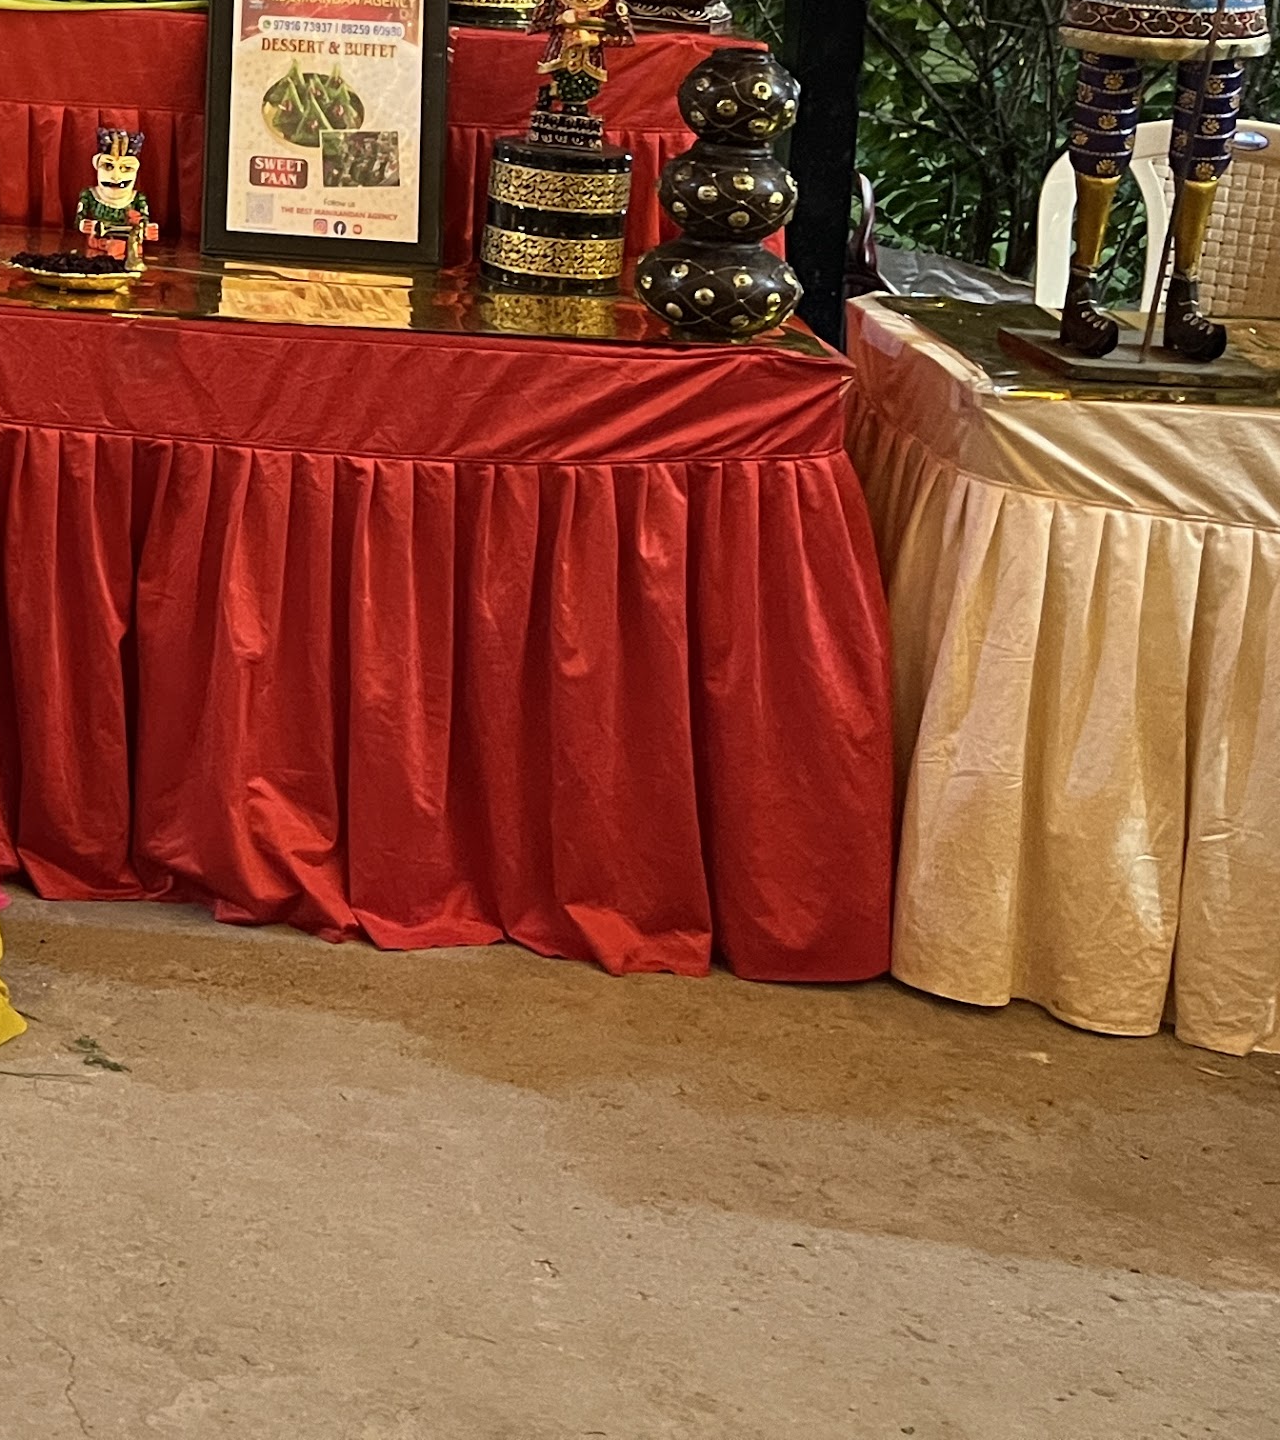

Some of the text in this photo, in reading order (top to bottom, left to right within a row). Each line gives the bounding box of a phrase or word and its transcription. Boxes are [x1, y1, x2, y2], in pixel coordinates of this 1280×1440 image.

[273, 20, 301, 32] 97916
[303, 21, 333, 33] 73937
[341, 23, 370, 36] 88259
[261, 37, 397, 58] DESSERT & BUFFET
[254, 156, 305, 173] SWEET
[260, 171, 298, 186] PAAN
